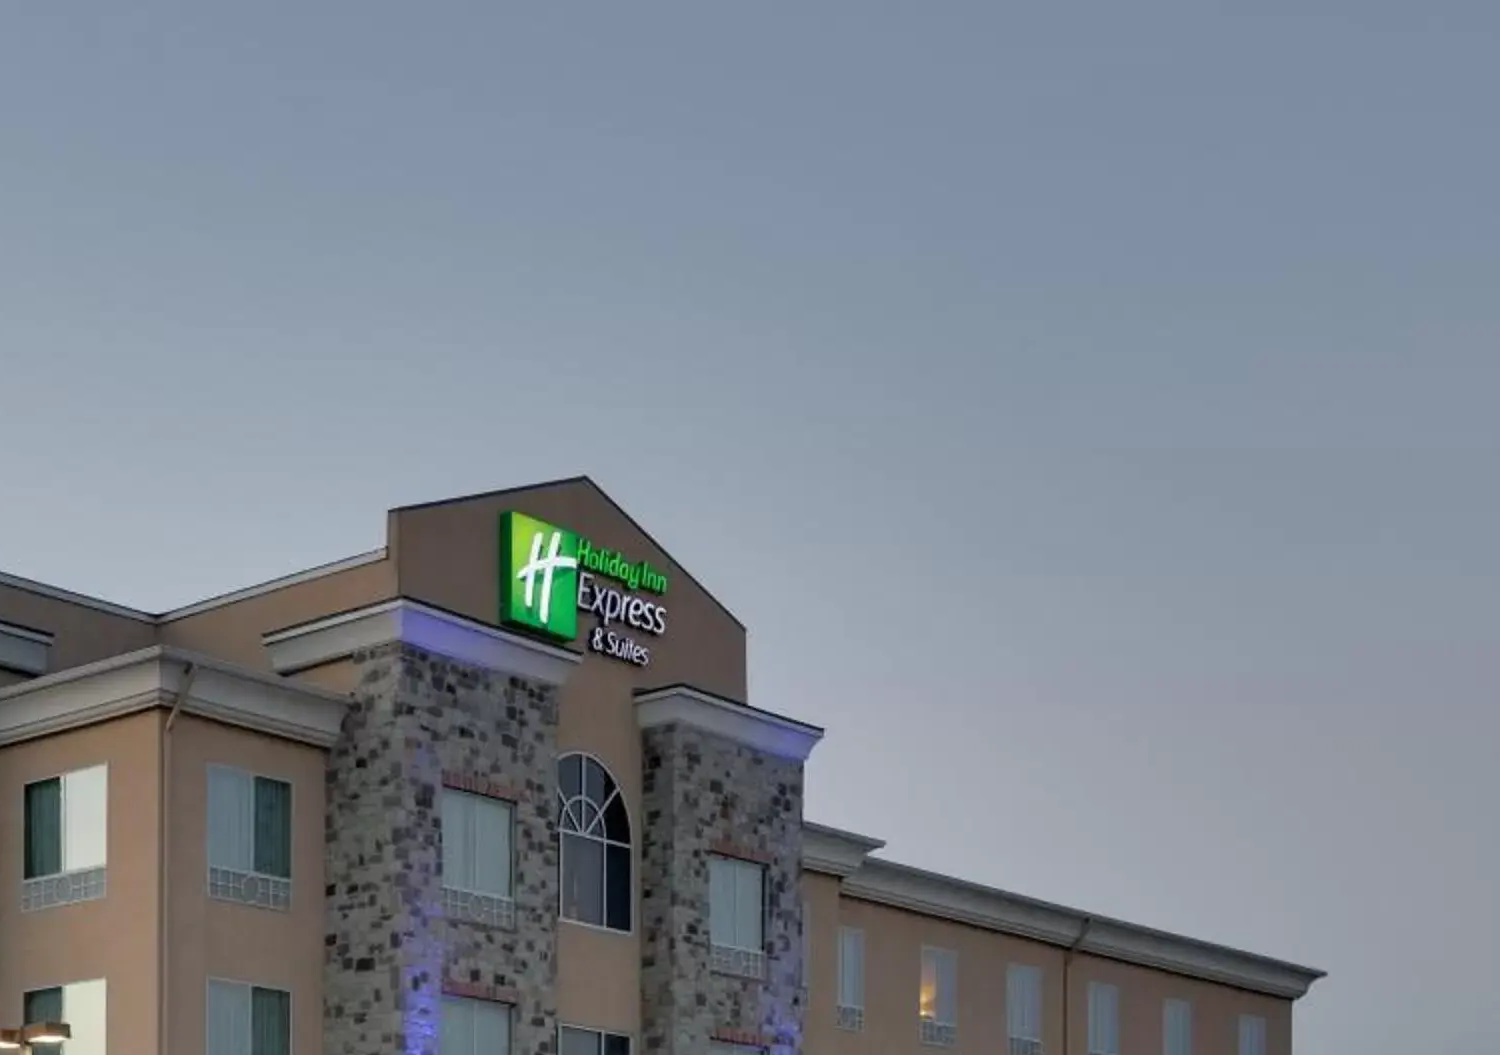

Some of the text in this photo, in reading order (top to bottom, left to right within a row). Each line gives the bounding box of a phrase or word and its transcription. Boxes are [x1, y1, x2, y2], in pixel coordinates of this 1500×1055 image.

[577, 538, 667, 592] Holiday Inn
[577, 572, 667, 634] Express
[592, 627, 649, 666] & Suites
